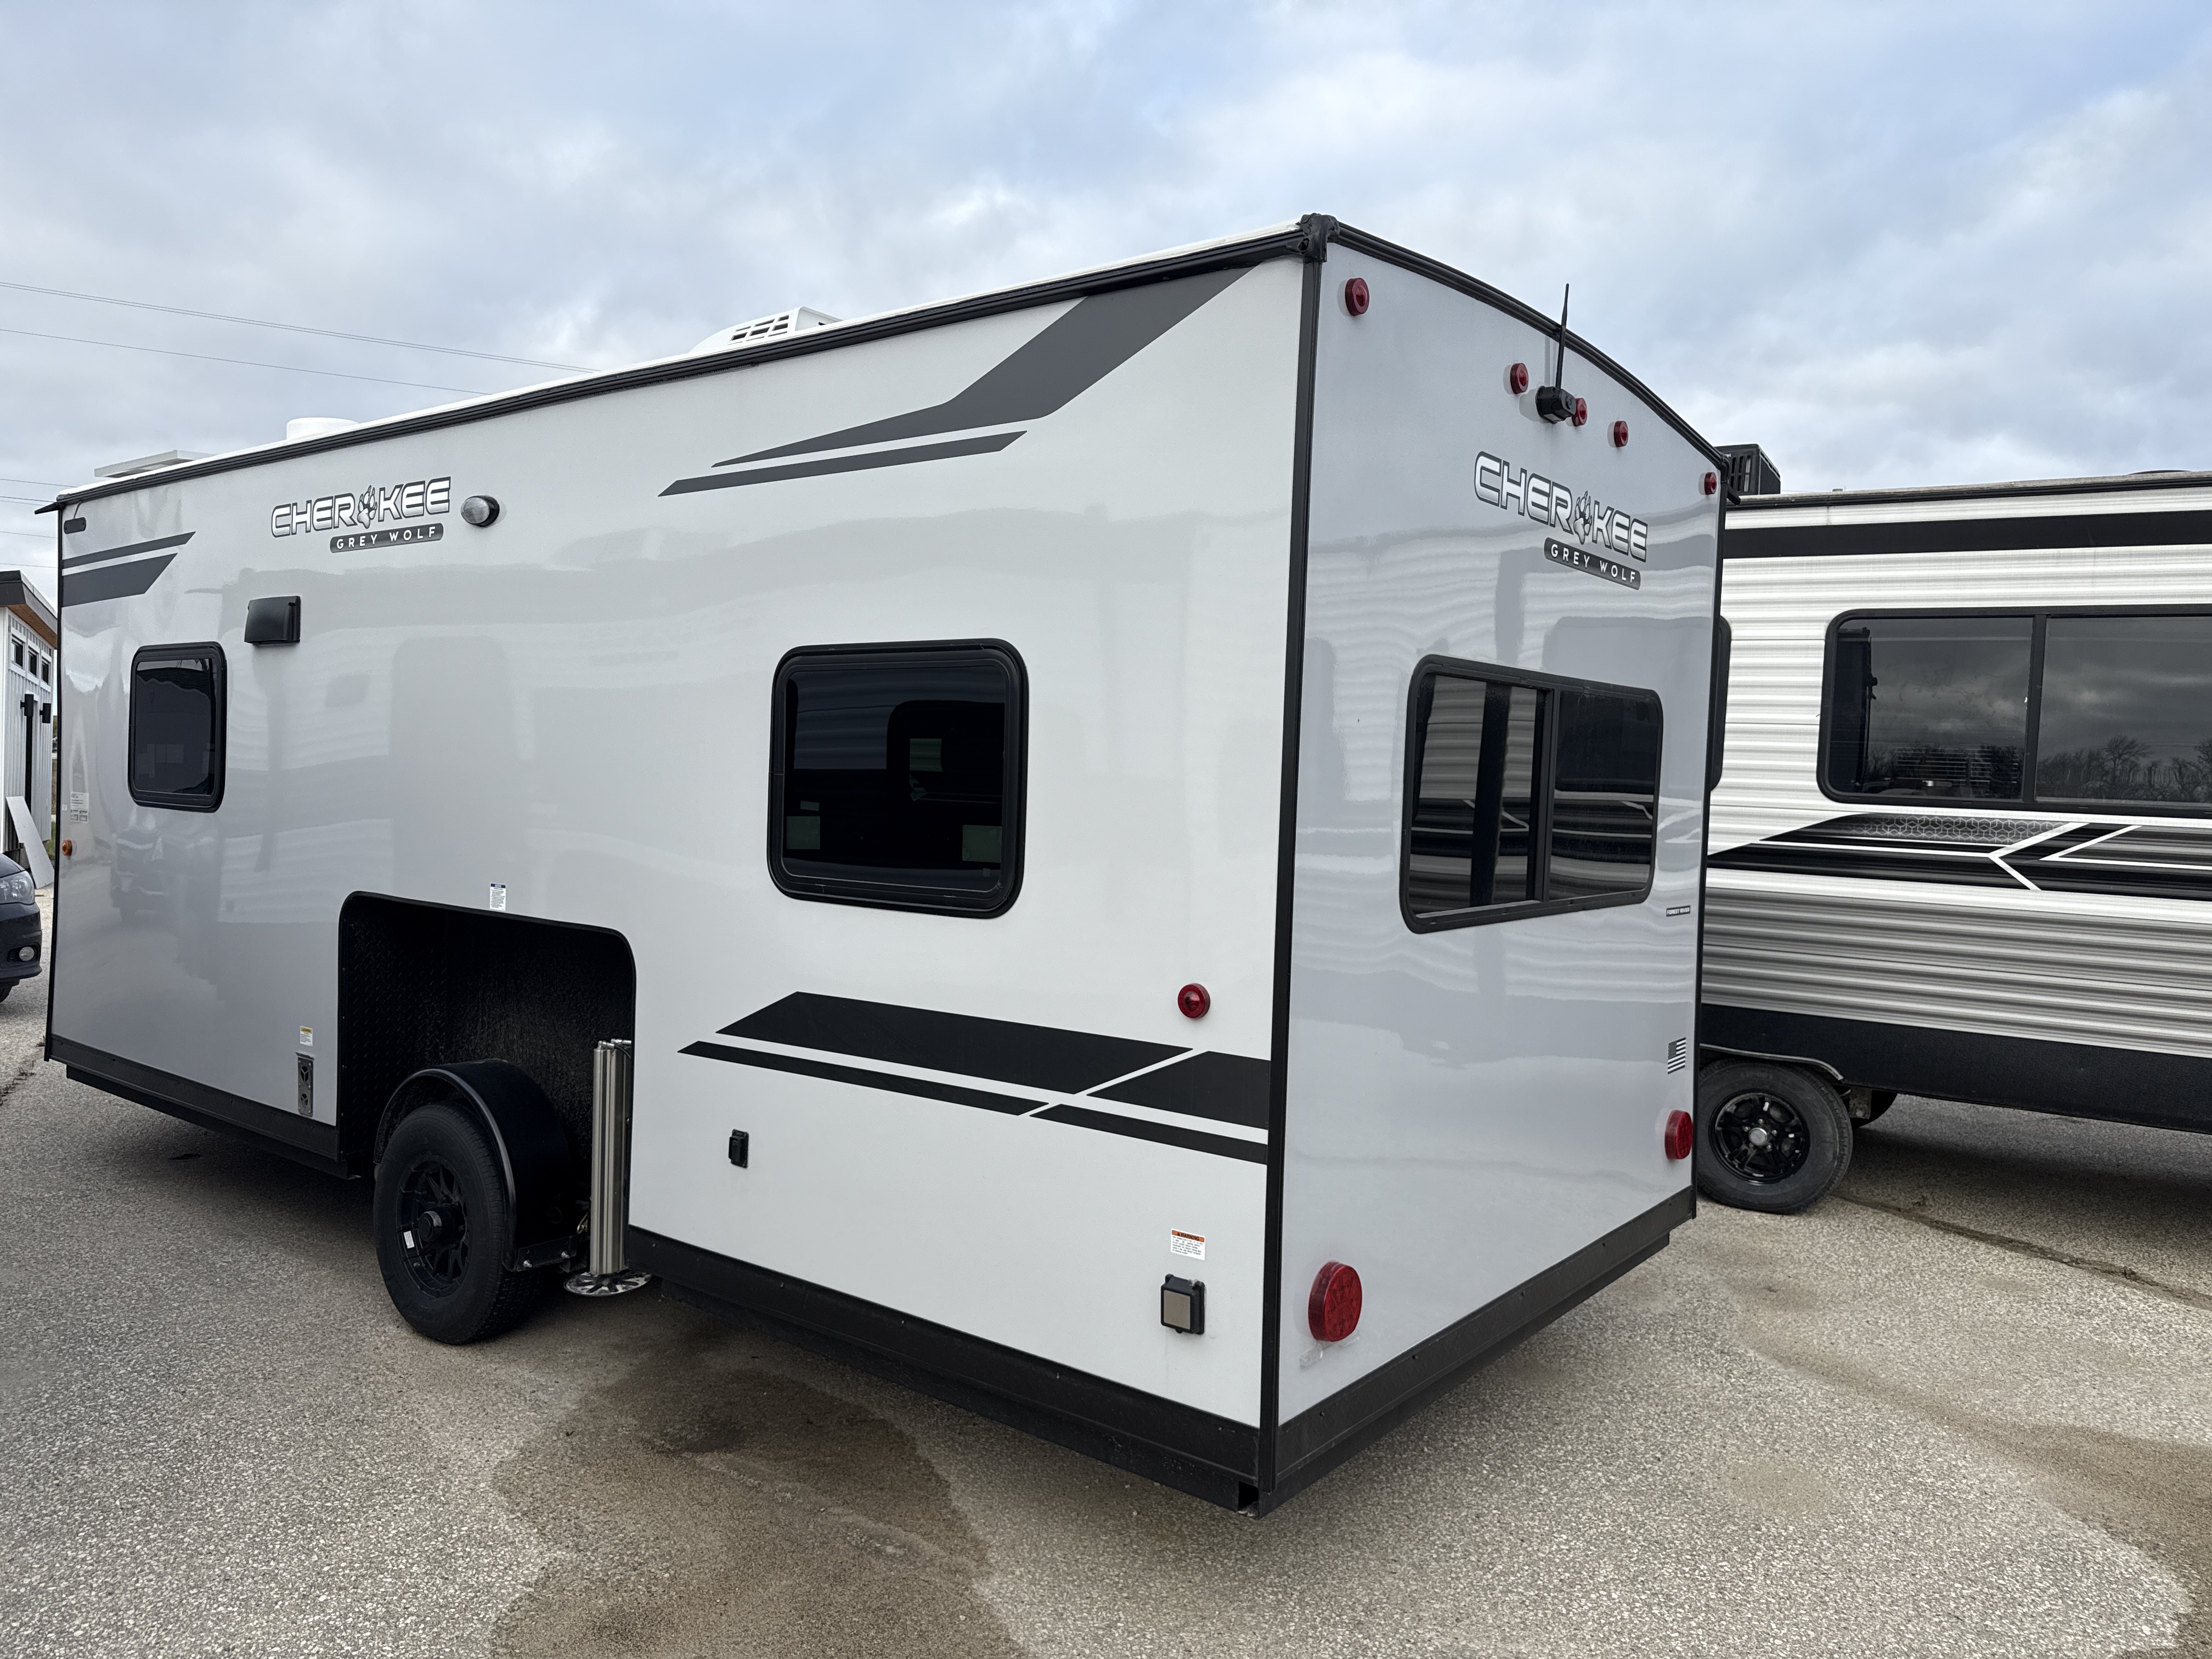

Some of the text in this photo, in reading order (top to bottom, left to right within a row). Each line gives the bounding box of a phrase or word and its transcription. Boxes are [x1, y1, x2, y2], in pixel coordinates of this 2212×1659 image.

[336, 526, 436, 550] GREY WOLF
[1551, 544, 1636, 584] GREY WOLF
